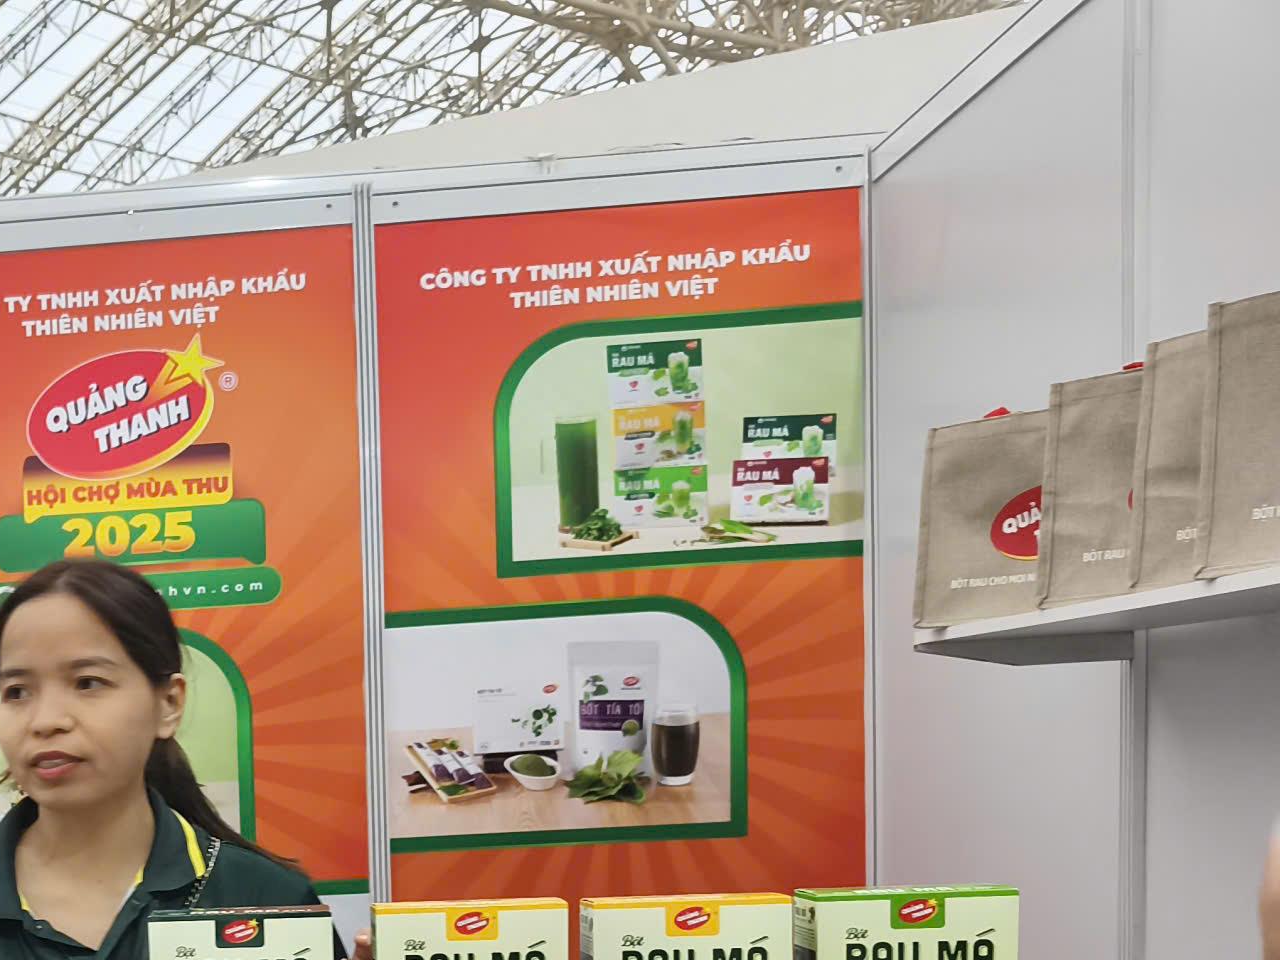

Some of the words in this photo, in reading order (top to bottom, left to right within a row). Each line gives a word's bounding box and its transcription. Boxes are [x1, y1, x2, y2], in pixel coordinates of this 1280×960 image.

[420, 268, 486, 290] CÔNG
[492, 267, 522, 285] TY
[527, 261, 592, 282] TNHH
[598, 250, 662, 276] XUẤT
[667, 247, 735, 272] NHẬP
[741, 239, 811, 265] KHẨU
[4, 296, 32, 313] TY
[37, 290, 99, 311] TNHH
[105, 280, 166, 305] XUẤT
[170, 277, 235, 301] NHẬP
[241, 269, 306, 295] KHẨU
[510, 286, 580, 308] THIÊN
[586, 282, 659, 303] NHIÊN
[665, 277, 718, 298] VIỆT
[22, 315, 88, 337] THIÊN
[94, 310, 162, 332] NHIÊN
[170, 306, 220, 326] VIỆT
[45, 375, 150, 434] QUẢNG
[93, 396, 192, 454] THANH
[27, 485, 67, 507] HỘI
[72, 481, 121, 504] CHỢ
[126, 475, 177, 500] MÙA
[182, 475, 228, 495] THU
[61, 510, 196, 557] 2025
[1002, 501, 1042, 534] QUẢ
[404, 940, 426, 952] Bột
[845, 928, 868, 940] Bột
